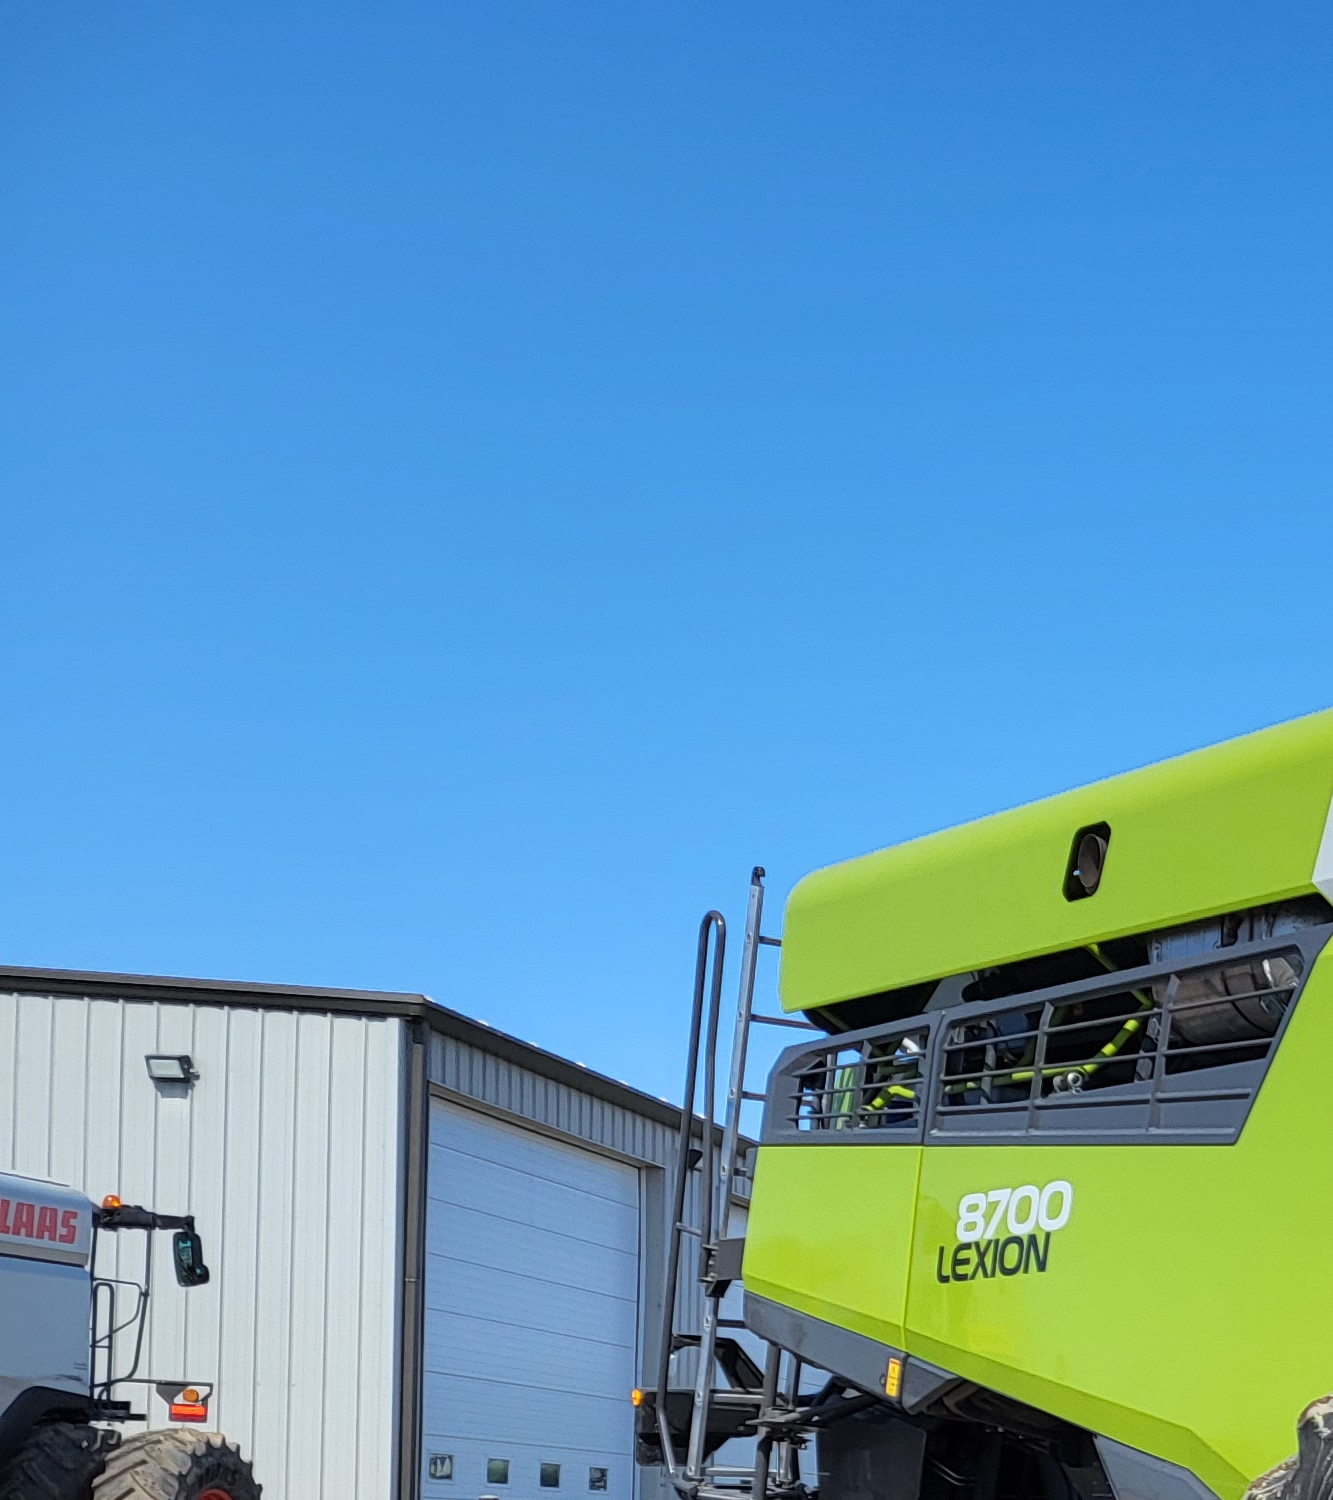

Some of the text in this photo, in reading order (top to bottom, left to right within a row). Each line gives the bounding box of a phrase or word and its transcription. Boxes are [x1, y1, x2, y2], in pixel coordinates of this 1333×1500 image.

[0, 1198, 79, 1245] LAAS
[956, 1180, 1073, 1243] 8700
[936, 1231, 1052, 1284] LEXION
